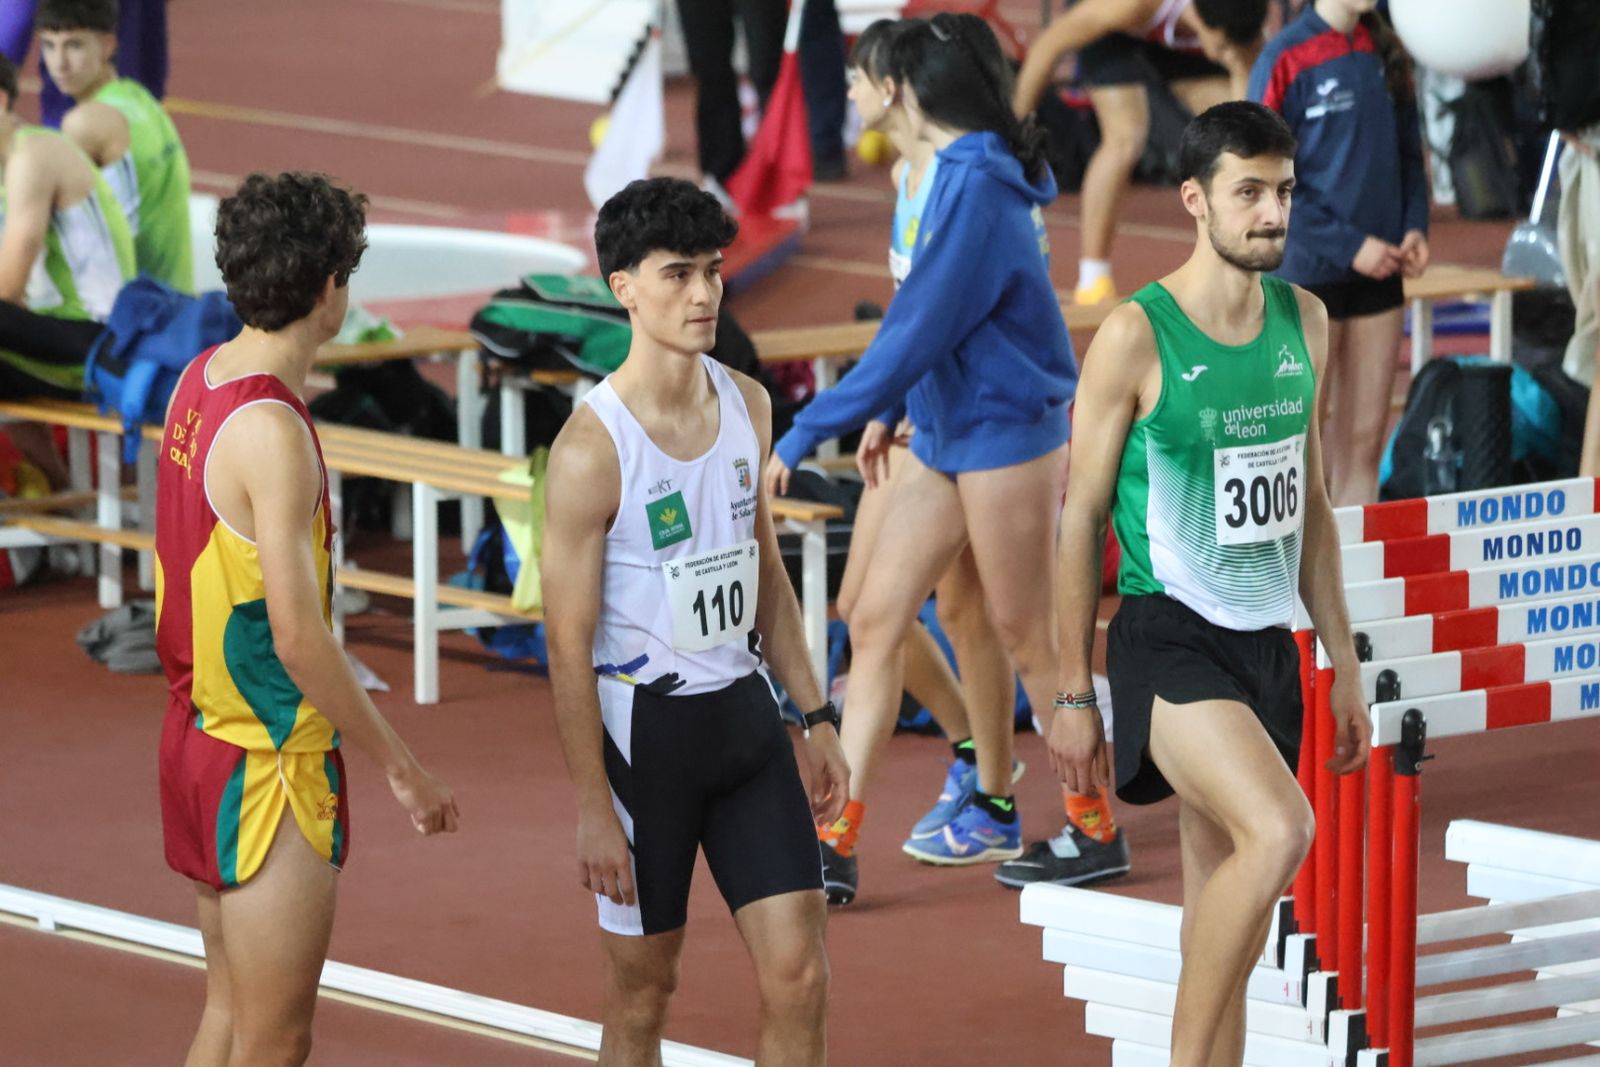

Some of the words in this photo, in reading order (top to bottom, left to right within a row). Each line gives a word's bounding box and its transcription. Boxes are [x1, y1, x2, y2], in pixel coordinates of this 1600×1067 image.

[1222, 396, 1303, 423] universidad
[1237, 450, 1269, 459] FEDERACIÓN
[1223, 466, 1298, 529] 3006
[1457, 489, 1566, 528] MONDO
[685, 556, 713, 569] FEDERACIÓN
[720, 549, 743, 560] ATLETISMO
[1482, 527, 1582, 562] MONDO
[702, 565, 723, 575] CASTILLA
[727, 560, 739, 569] LEÓN
[1498, 562, 1600, 600] MONDO
[692, 580, 744, 637] 110
[1527, 601, 1600, 635] MON
[1553, 643, 1600, 673] MO
